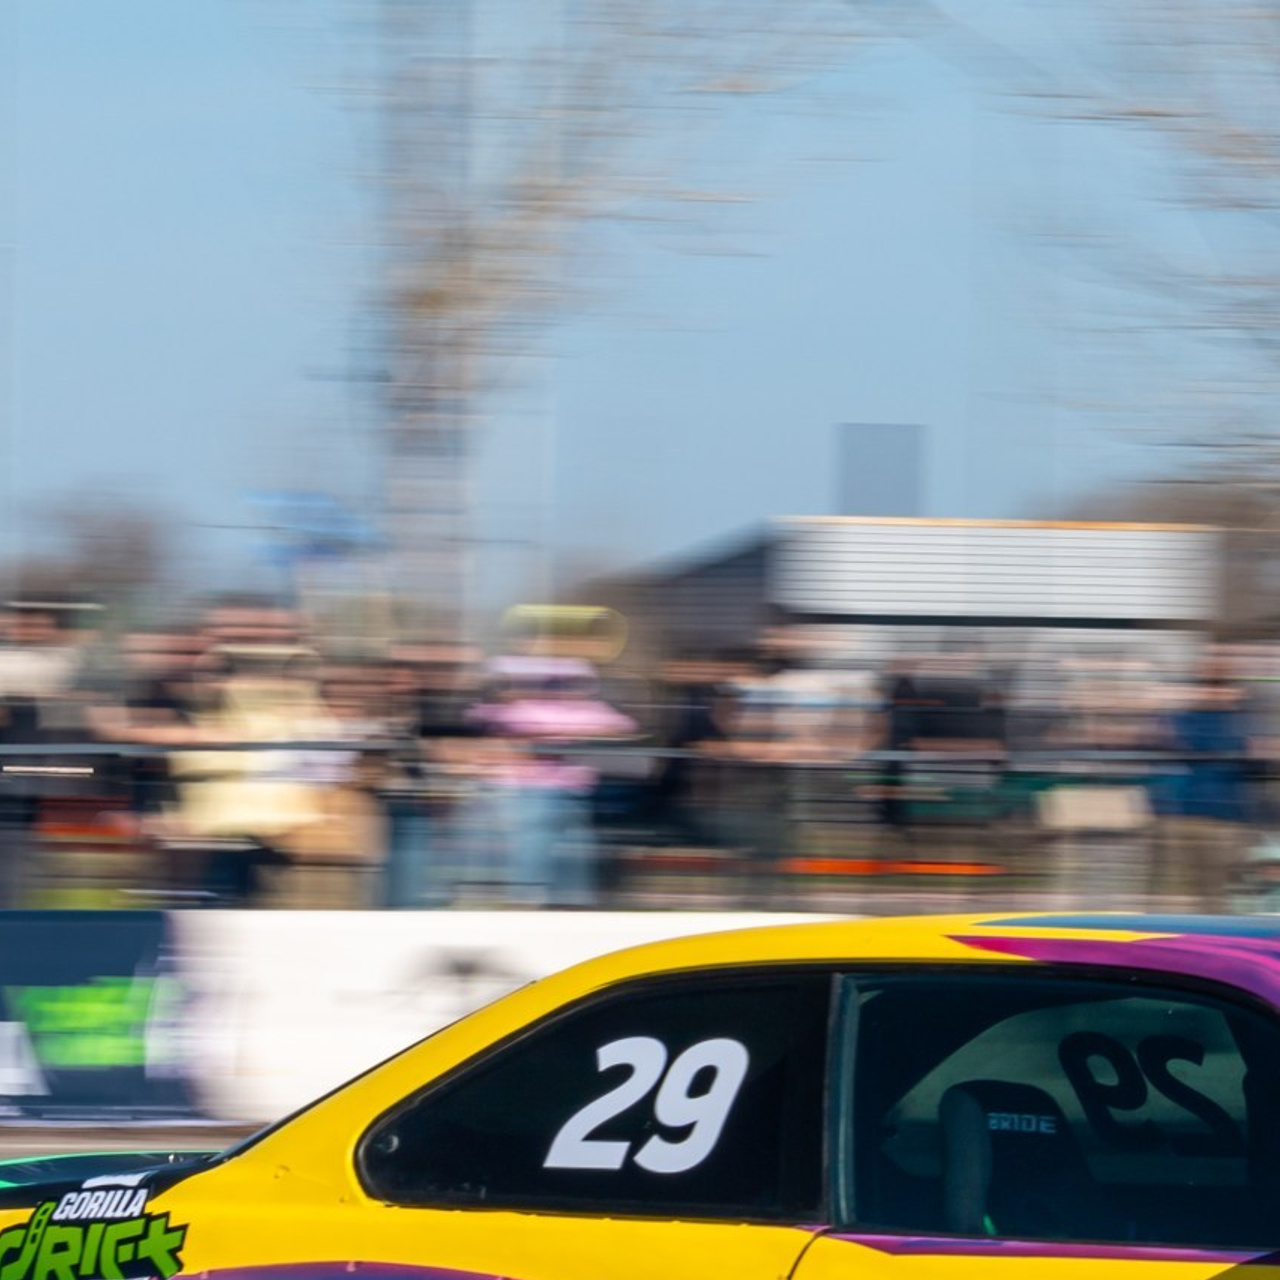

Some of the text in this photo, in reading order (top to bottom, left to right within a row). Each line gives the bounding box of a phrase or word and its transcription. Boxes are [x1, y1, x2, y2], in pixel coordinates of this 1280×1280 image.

[543, 1036, 749, 1173] 29
[987, 1112, 1057, 1134] BRIDE
[52, 1188, 148, 1220] GORILLA
